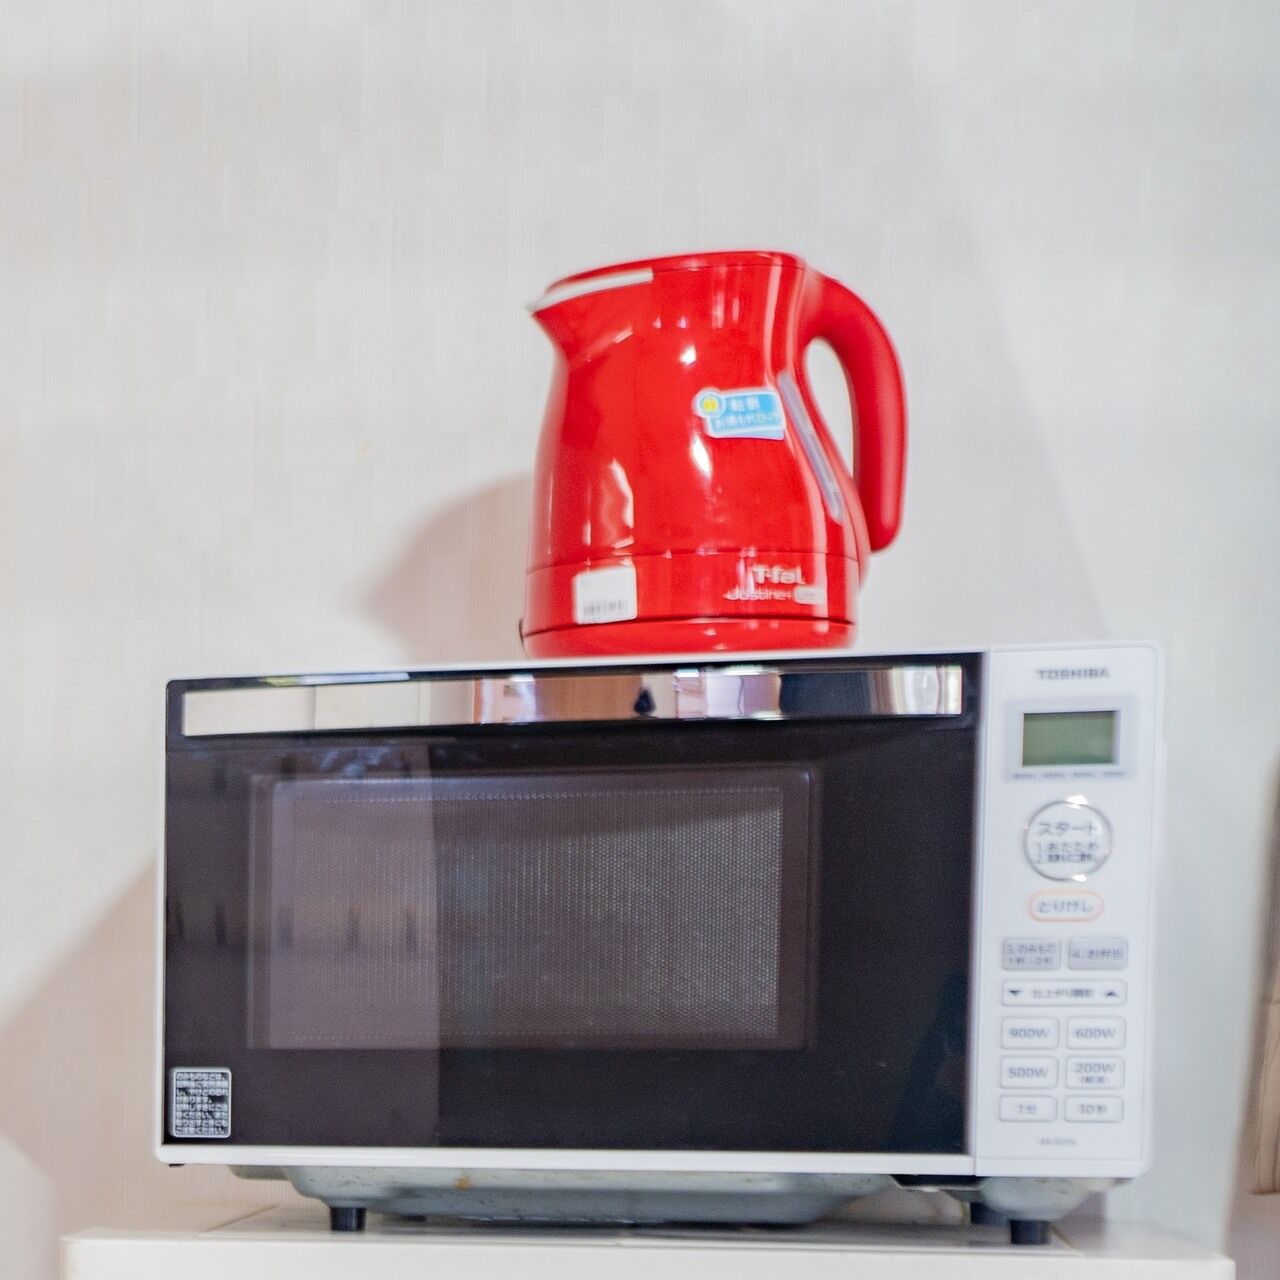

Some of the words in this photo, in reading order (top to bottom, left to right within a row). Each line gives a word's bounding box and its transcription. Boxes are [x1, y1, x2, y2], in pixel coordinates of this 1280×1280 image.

[1038, 668, 1110, 680] TOSHIBA
[1039, 822, 1097, 836] スタート
[1037, 901, 1093, 913] とりけし
[1010, 1028, 1050, 1039] 900W
[1075, 1028, 1116, 1039] 600W
[1008, 1067, 1049, 1078] 500W
[1075, 1063, 1116, 1073] 200W
